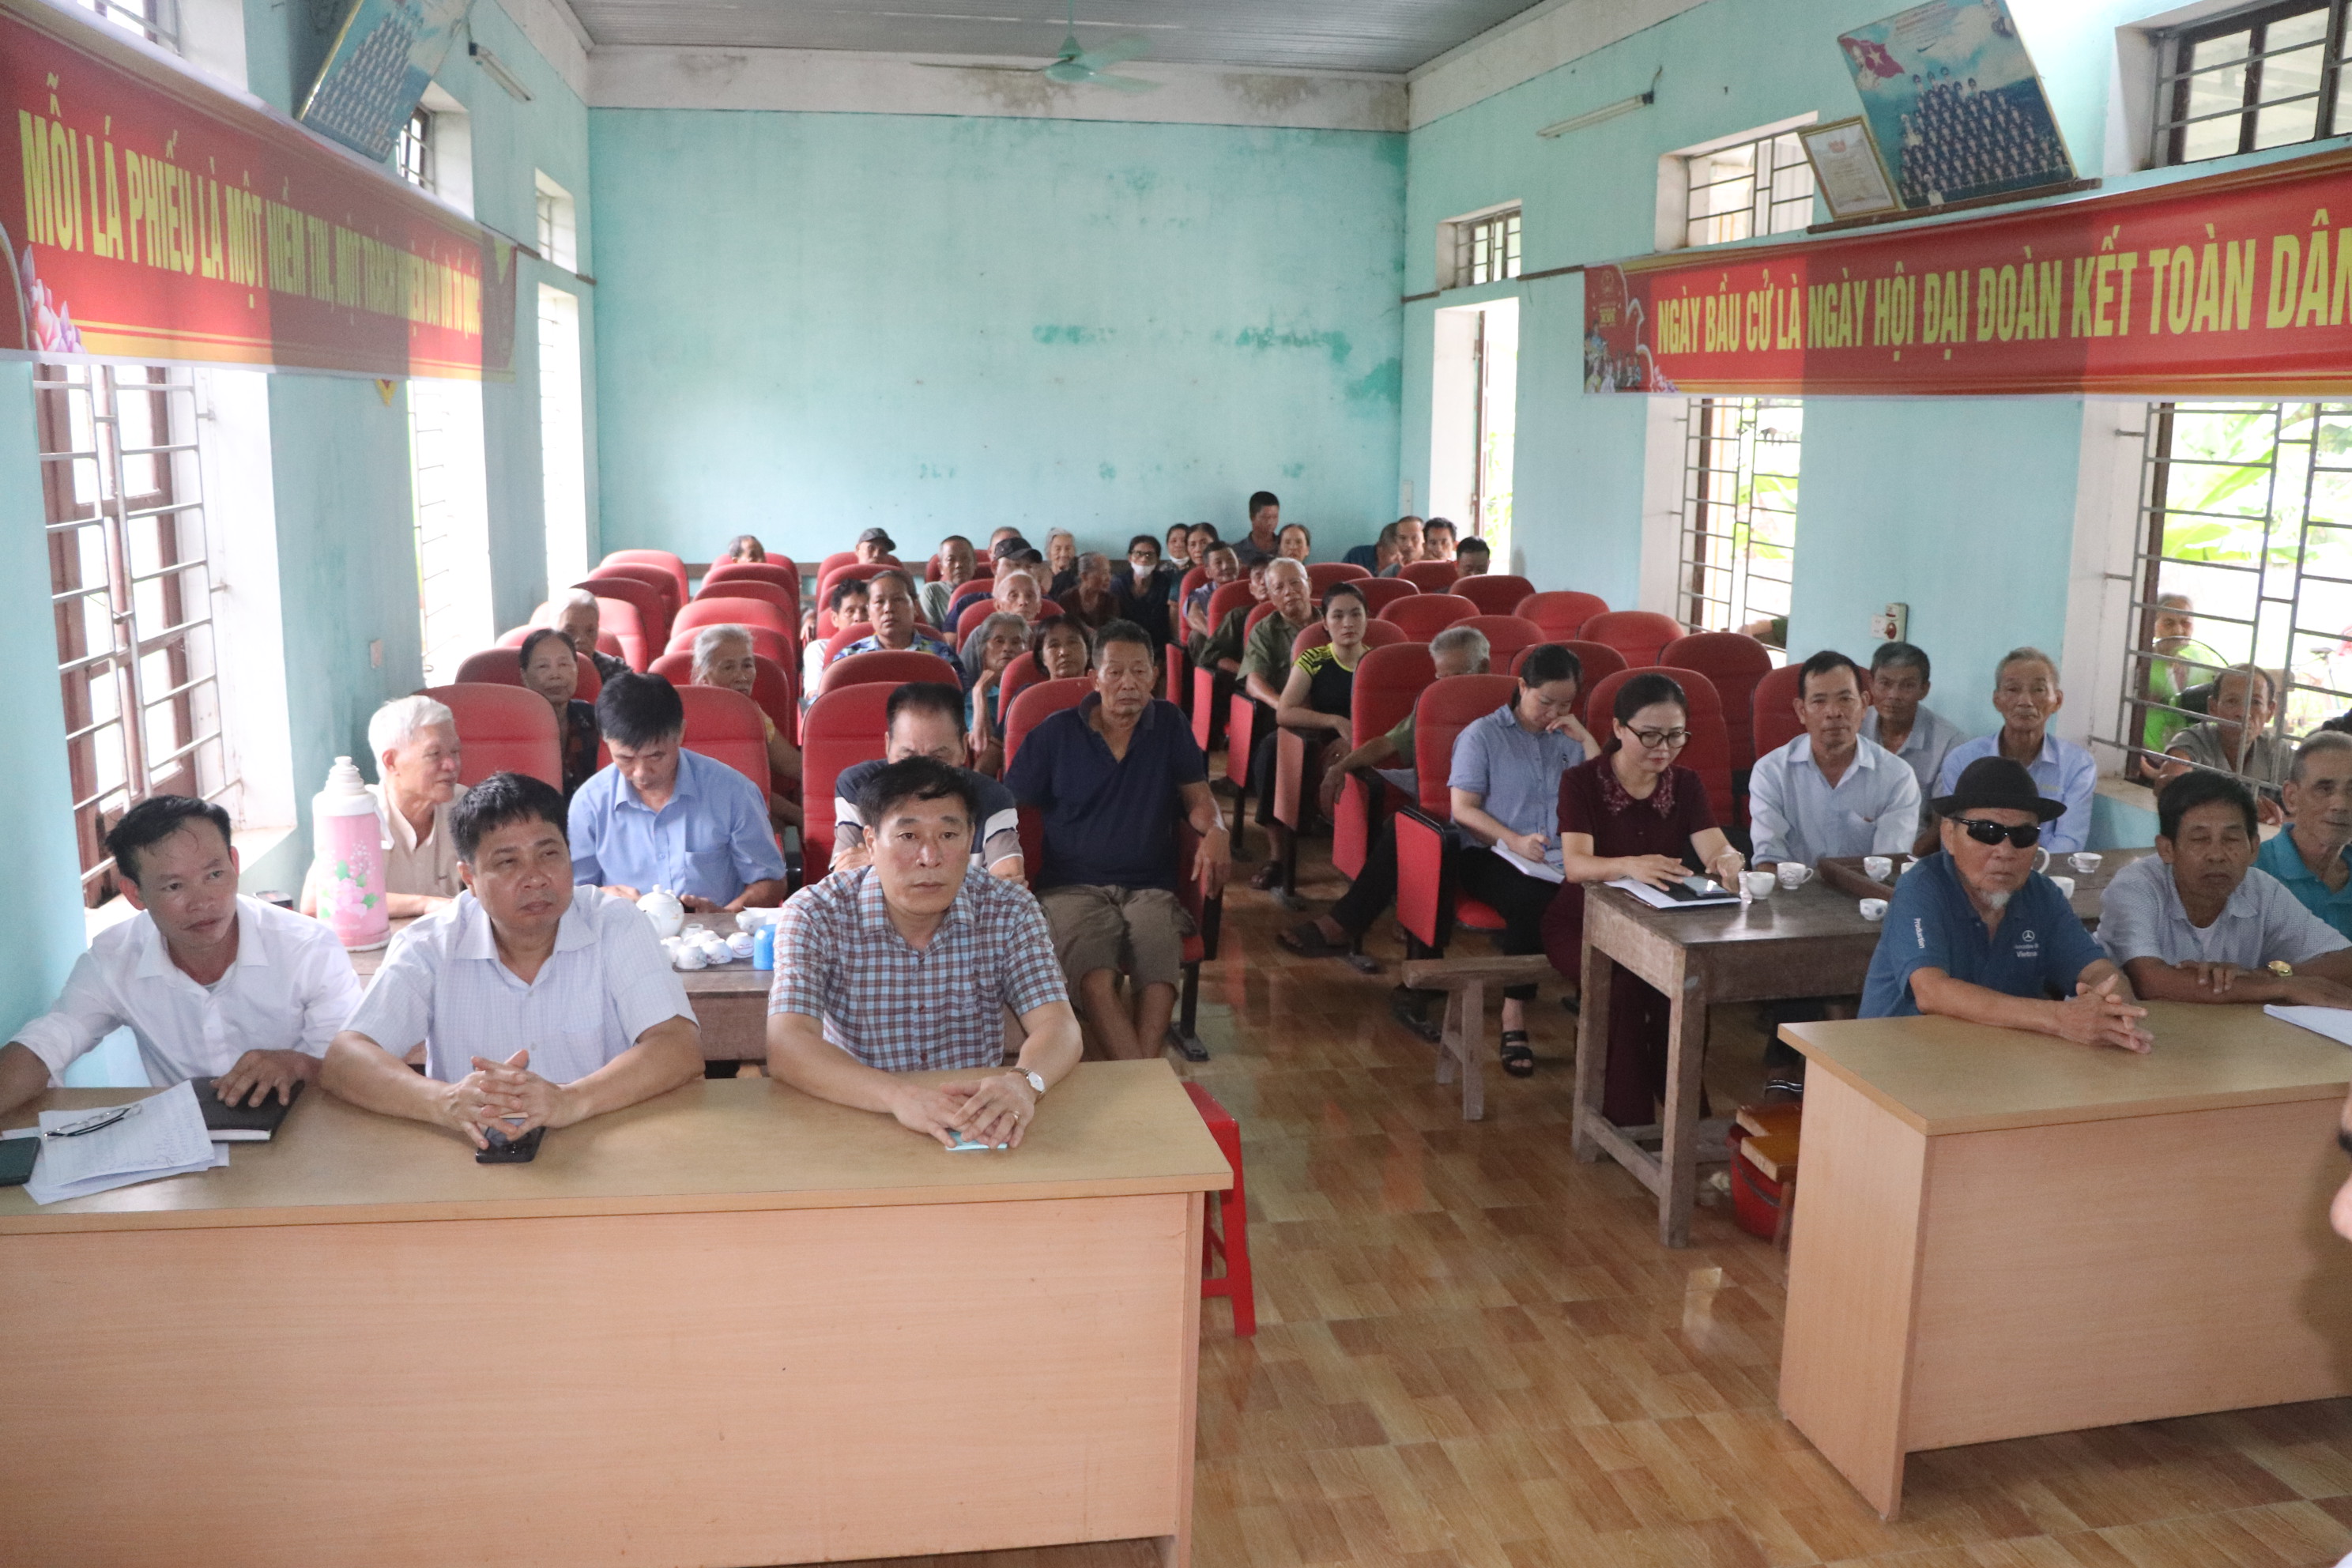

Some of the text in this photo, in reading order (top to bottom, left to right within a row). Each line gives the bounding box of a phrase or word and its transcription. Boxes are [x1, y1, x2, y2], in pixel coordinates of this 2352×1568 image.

[18, 72, 84, 252] MỖI
[86, 115, 125, 261] LÁ
[125, 129, 195, 276] PHIẾU
[198, 156, 225, 281] LÀ
[225, 170, 264, 308] MỘT
[266, 175, 307, 296] NIỀM
[307, 214, 334, 314] TIN,
[335, 212, 361, 326] MỘT
[1657, 285, 1701, 355] NGÀY
[1704, 272, 1741, 353] BẦU
[1745, 268, 1774, 352] CỬ
[1777, 273, 1802, 350] LÀ
[1807, 266, 1868, 349] NGÀY
[1873, 260, 1917, 362] HỘI
[1922, 269, 1969, 361] ĐẠI
[1977, 245, 2063, 342] ĐOÀN
[2071, 224, 2138, 338] KẾT
[2148, 222, 2256, 335] TOÀN
[1913, 918, 1926, 949] Production
